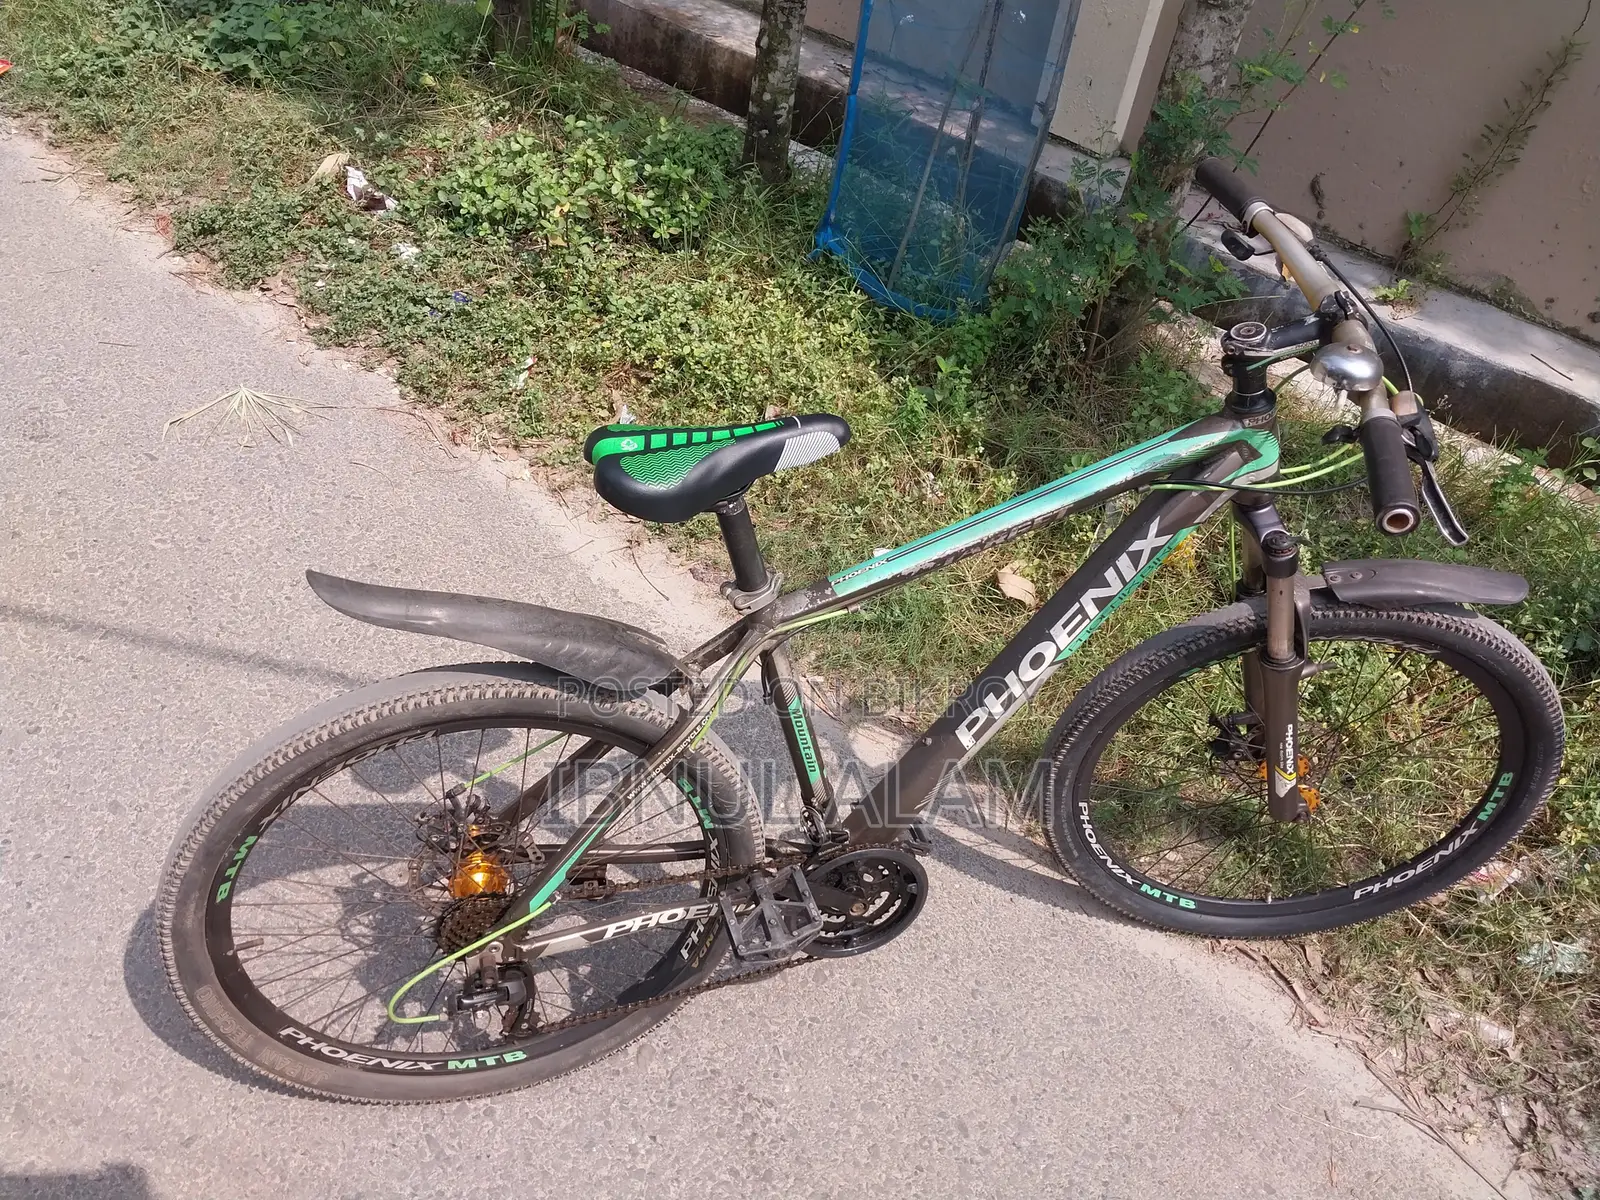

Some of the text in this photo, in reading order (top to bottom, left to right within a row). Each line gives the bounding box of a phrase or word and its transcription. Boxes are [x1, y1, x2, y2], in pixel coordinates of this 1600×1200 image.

[831, 559, 888, 586] PHOENIX
[955, 516, 1173, 750] PHOENIX
[259, 728, 438, 832] PHOENIX
[627, 707, 715, 800] WWW.PHOENIX-BICYCLE.CO
[789, 708, 817, 773] Mountain
[1285, 723, 1295, 775] PHOENIX
[678, 776, 714, 829] MTB
[1353, 821, 1479, 900] PHOENIX
[1476, 772, 1514, 822] MTB
[216, 835, 258, 904] MTB
[1079, 801, 1142, 888] PHOENIX
[1139, 883, 1197, 910] MTB
[194, 985, 332, 1086] JAPAN TECHNO
[279, 1027, 528, 1071] PHOENIX MTB
